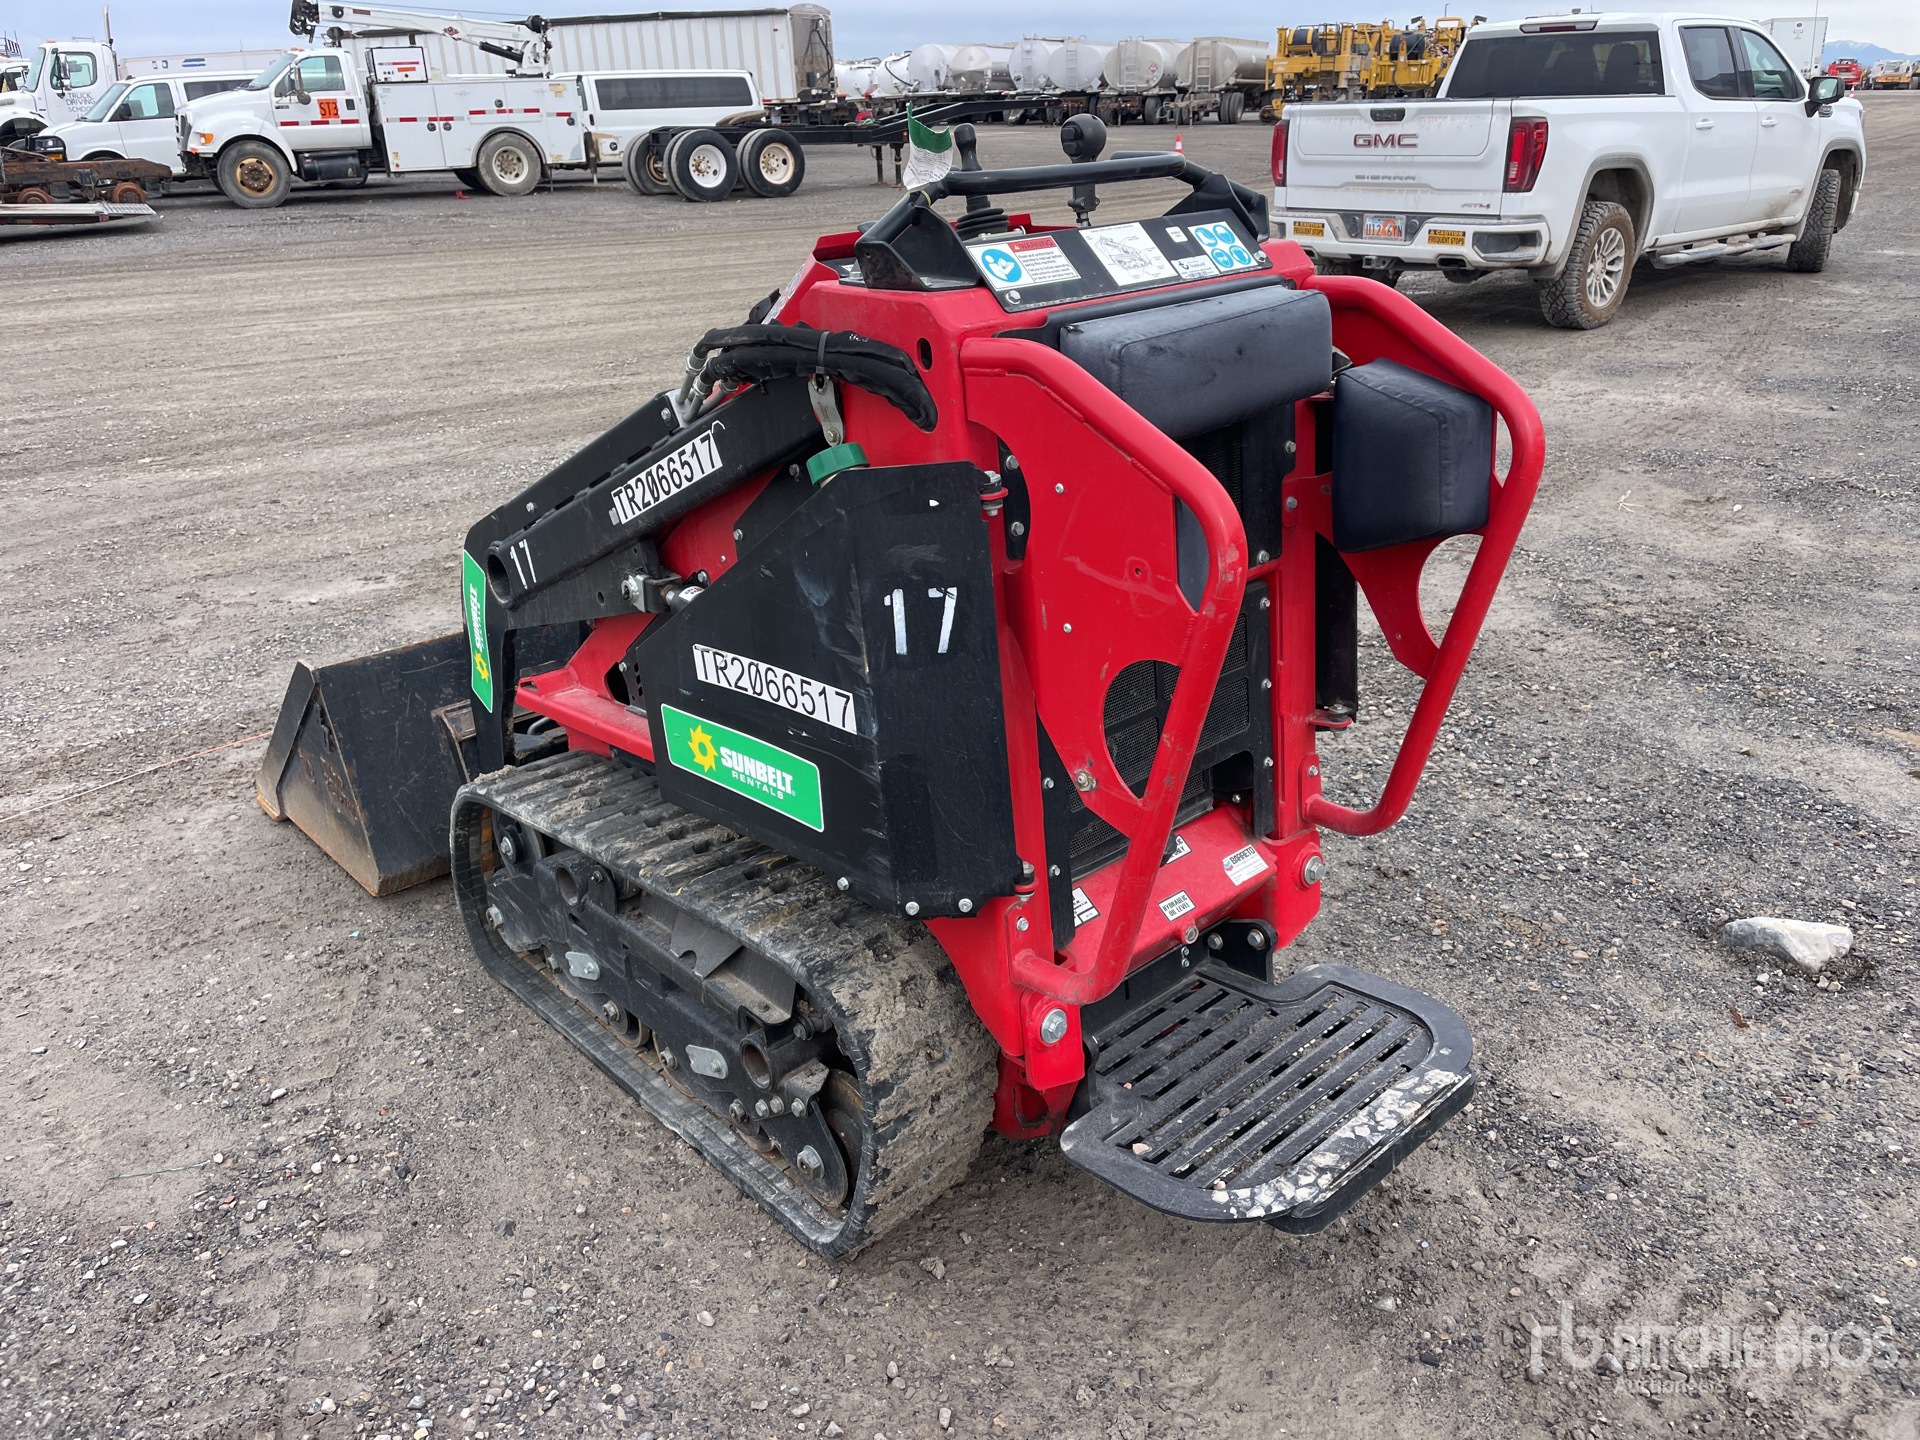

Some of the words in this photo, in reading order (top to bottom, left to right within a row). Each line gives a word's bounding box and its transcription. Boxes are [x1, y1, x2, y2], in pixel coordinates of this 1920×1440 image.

[319, 102, 339, 116] ST3
[1353, 134, 1418, 148] GMC
[1294, 227, 1312, 236] FREQUENT
[1312, 228, 1324, 237] STOPS
[1020, 240, 1054, 249] WARNING
[1428, 236, 1450, 245] FREQUENT
[1450, 237, 1465, 246] STOPS
[510, 539, 537, 590] 17
[720, 746, 793, 795] SUNBELT
[732, 770, 784, 800] RENTALS
[1230, 846, 1256, 865] BARRETO
[1162, 894, 1188, 912] HYDRAULIC
[1177, 902, 1190, 914] LEVEL
